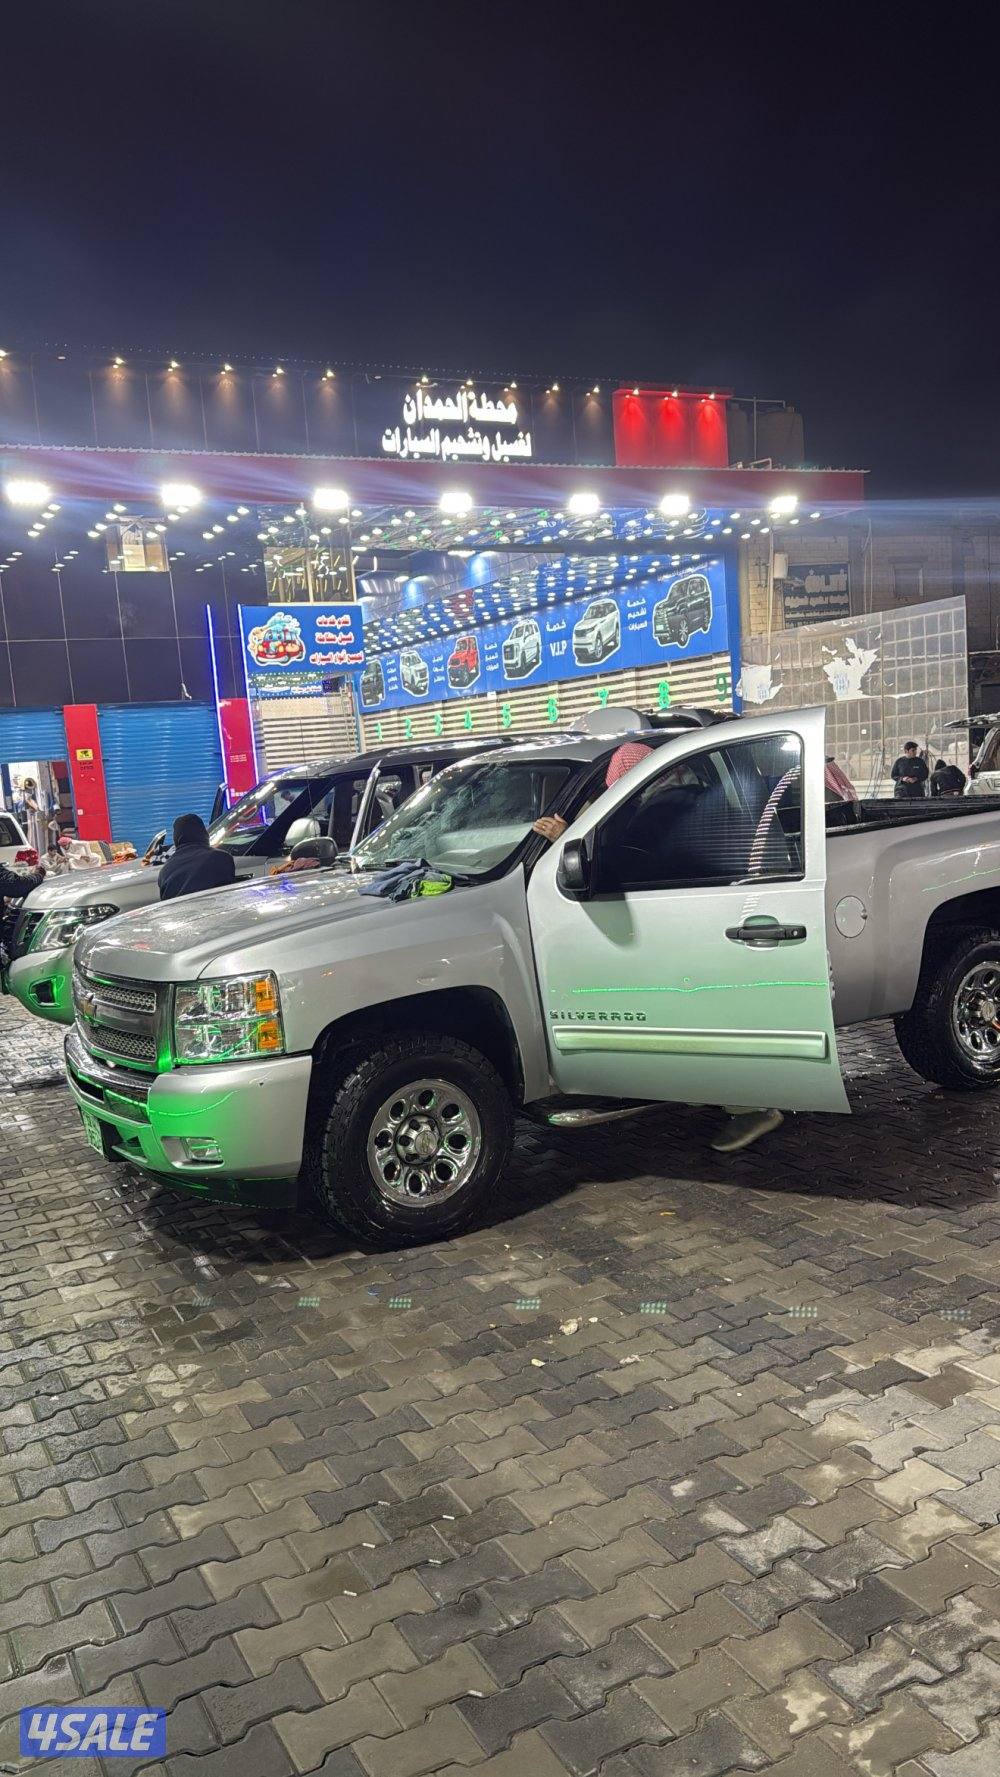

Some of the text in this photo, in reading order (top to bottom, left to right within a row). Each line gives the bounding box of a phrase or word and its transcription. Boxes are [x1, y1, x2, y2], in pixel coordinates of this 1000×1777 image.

[403, 388, 518, 425] محطة الحمدان
[381, 426, 532, 463] لغسيل وتشحيم السيارات
[545, 619, 567, 632] خدمة
[404, 717, 414, 740] 2
[434, 712, 443, 736] 3
[502, 703, 512, 729] 5
[547, 696, 559, 724] 6
[658, 679, 670, 710] 8
[716, 672, 728, 702] 9
[549, 1010, 647, 1022] SILVERADO
